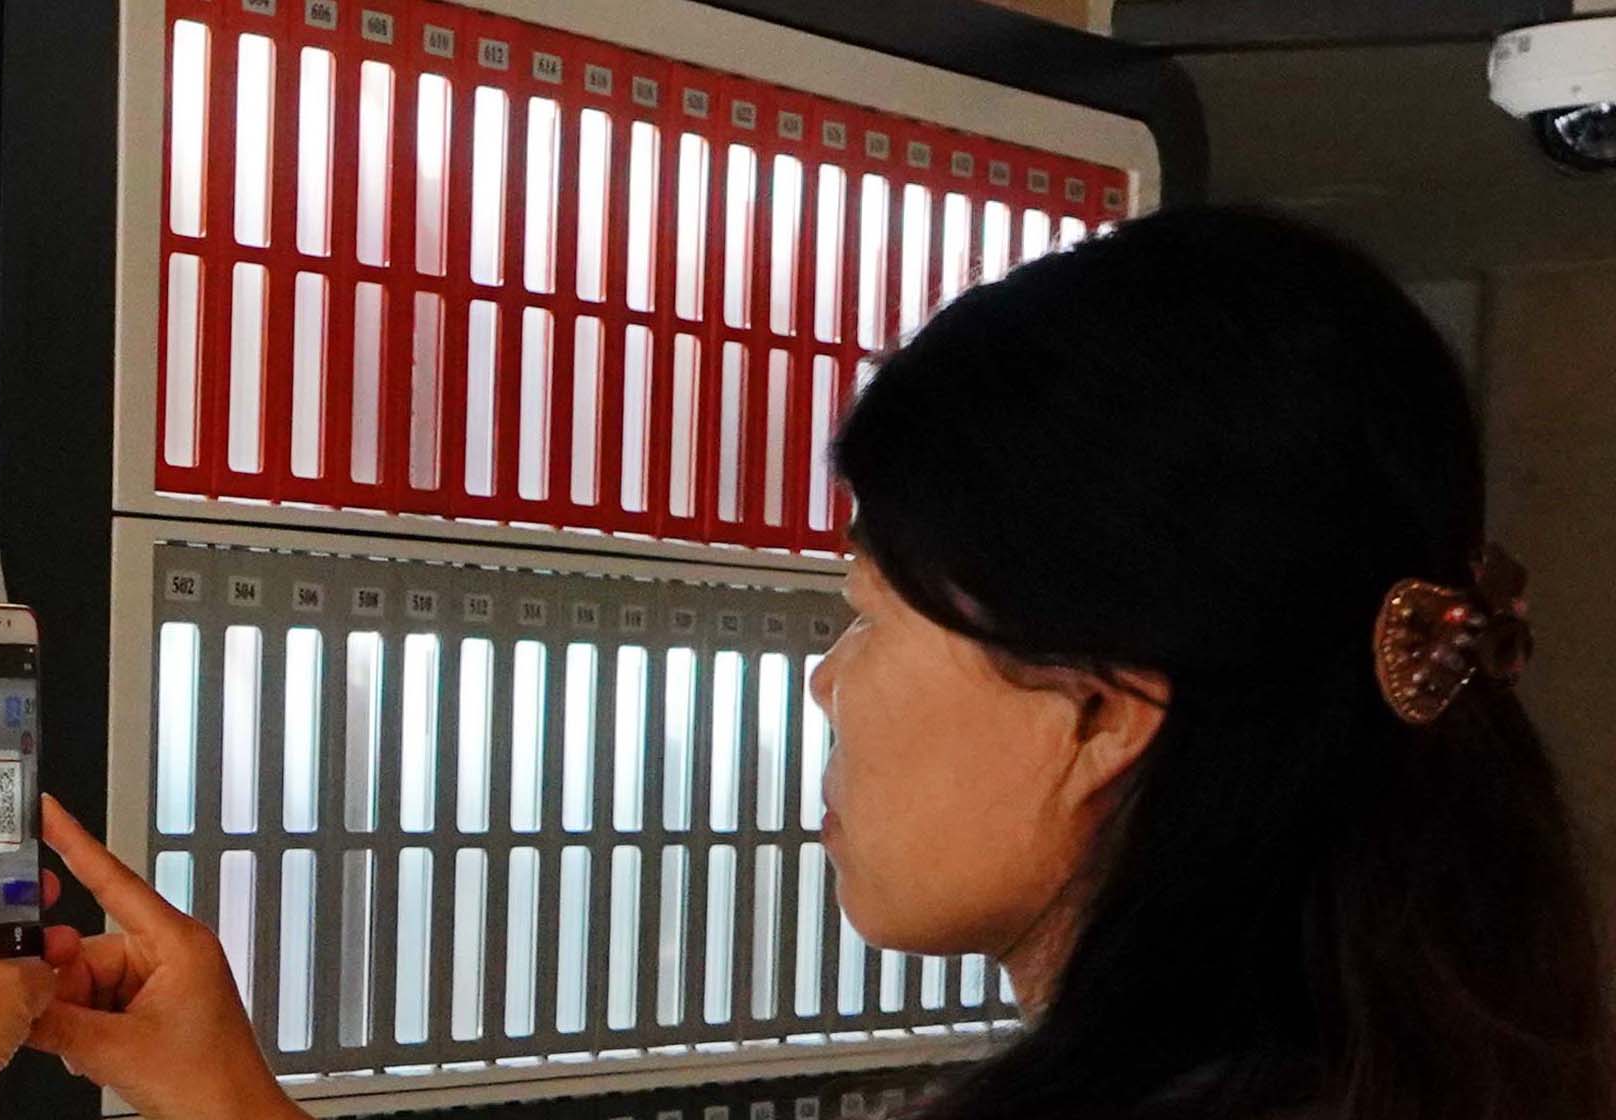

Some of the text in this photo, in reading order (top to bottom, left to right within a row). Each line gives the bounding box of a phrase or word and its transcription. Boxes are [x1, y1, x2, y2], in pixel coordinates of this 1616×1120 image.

[484, 43, 504, 64] 612
[171, 575, 195, 595] 502
[235, 581, 255, 601] 504
